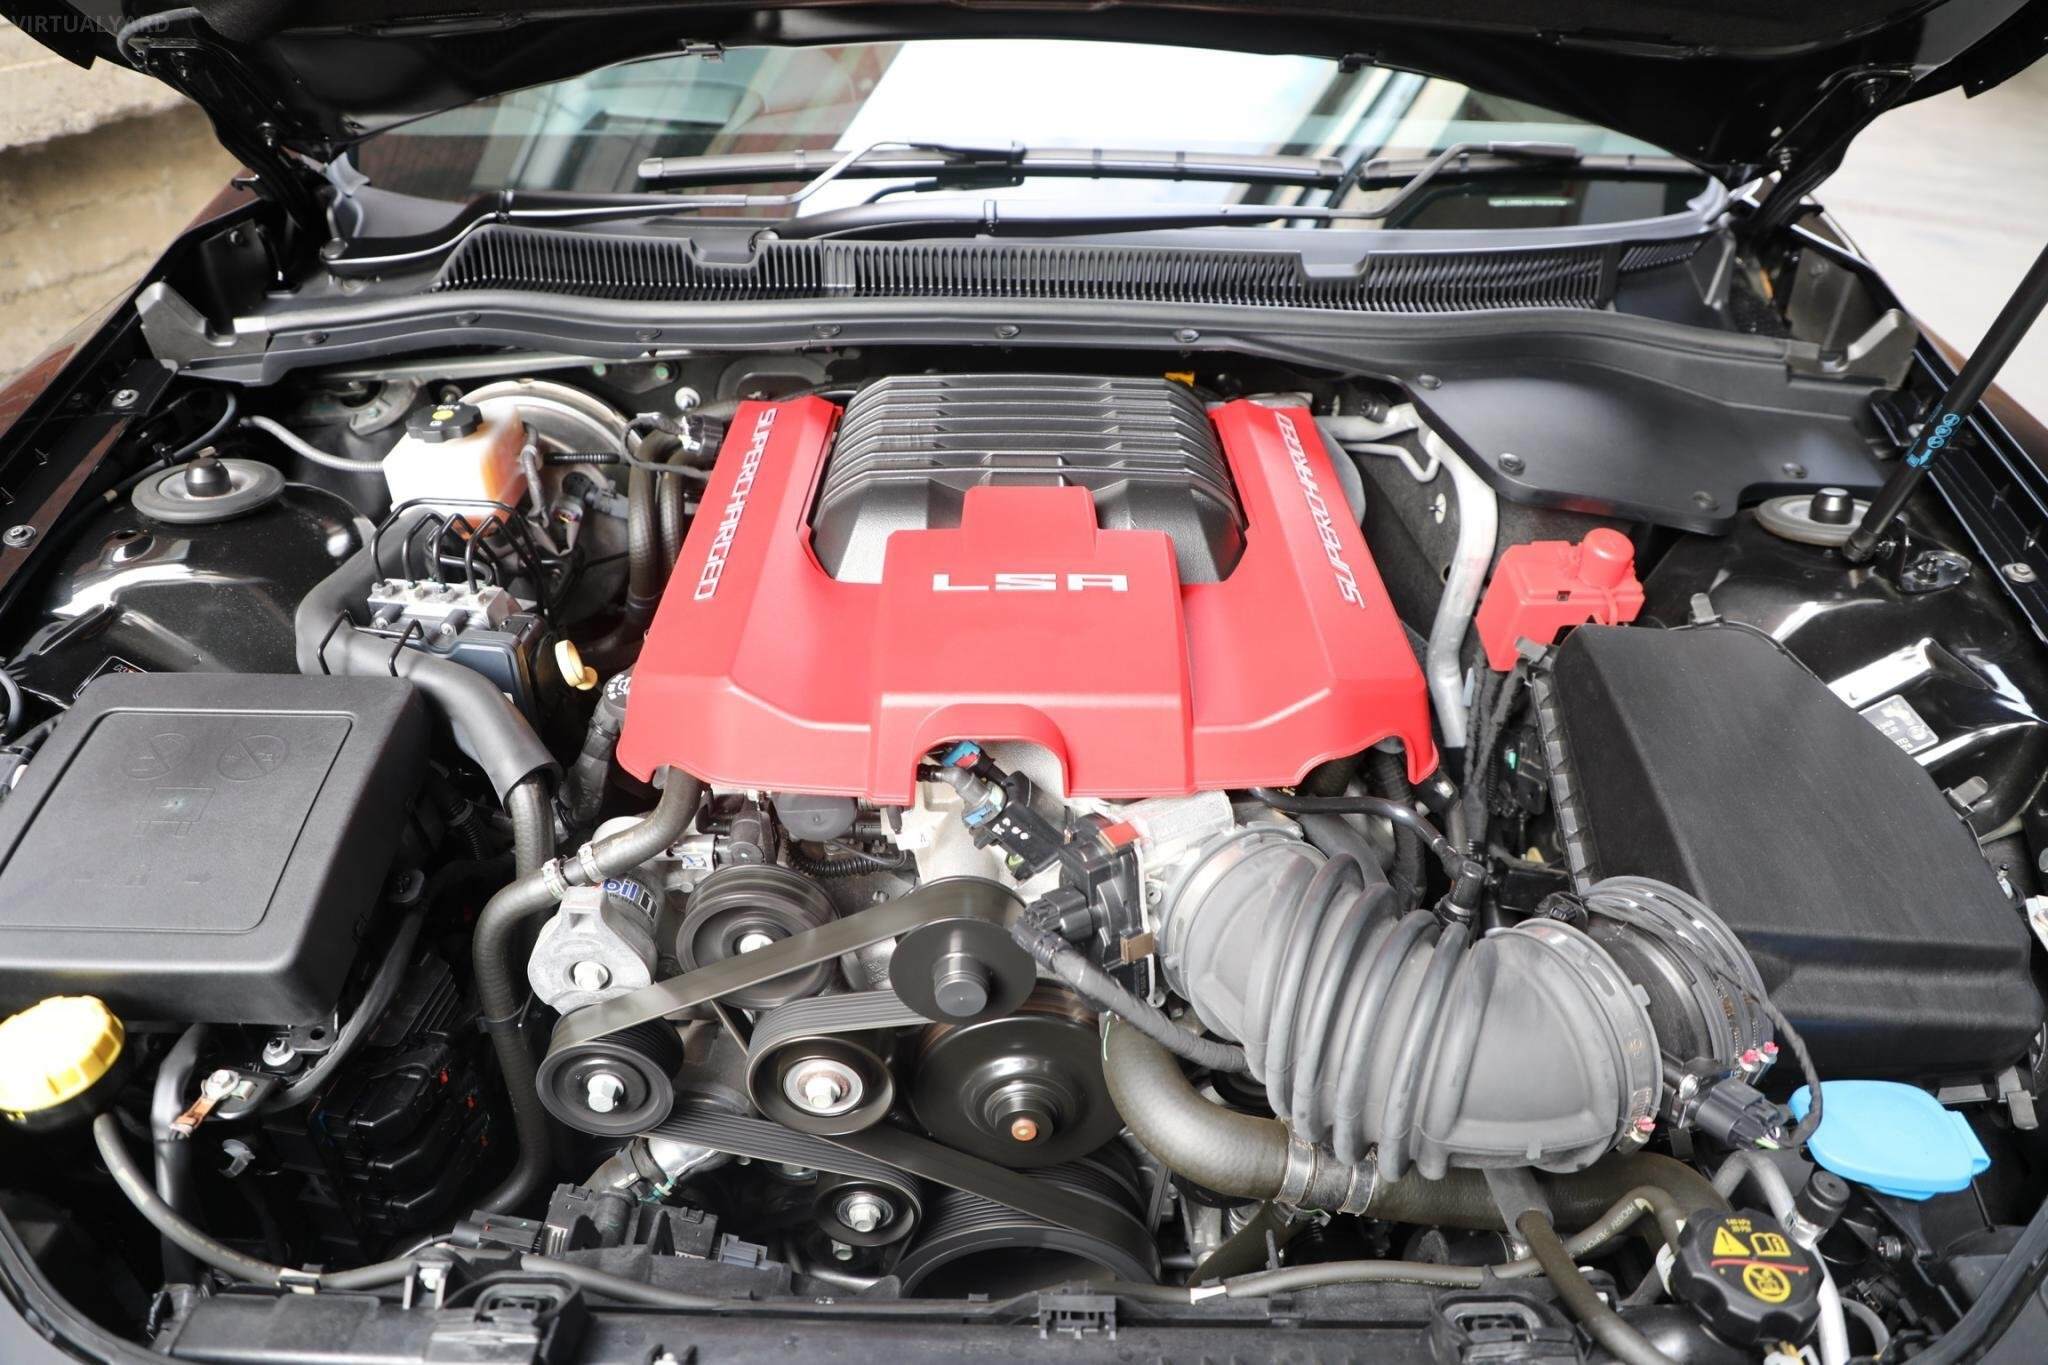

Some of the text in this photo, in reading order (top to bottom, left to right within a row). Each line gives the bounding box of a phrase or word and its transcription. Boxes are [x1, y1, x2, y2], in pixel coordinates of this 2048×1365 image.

[694, 407, 778, 601] SUPERCHARGED
[932, 573, 1129, 592] LSA
[1274, 410, 1366, 609] SUPERCHARGED
